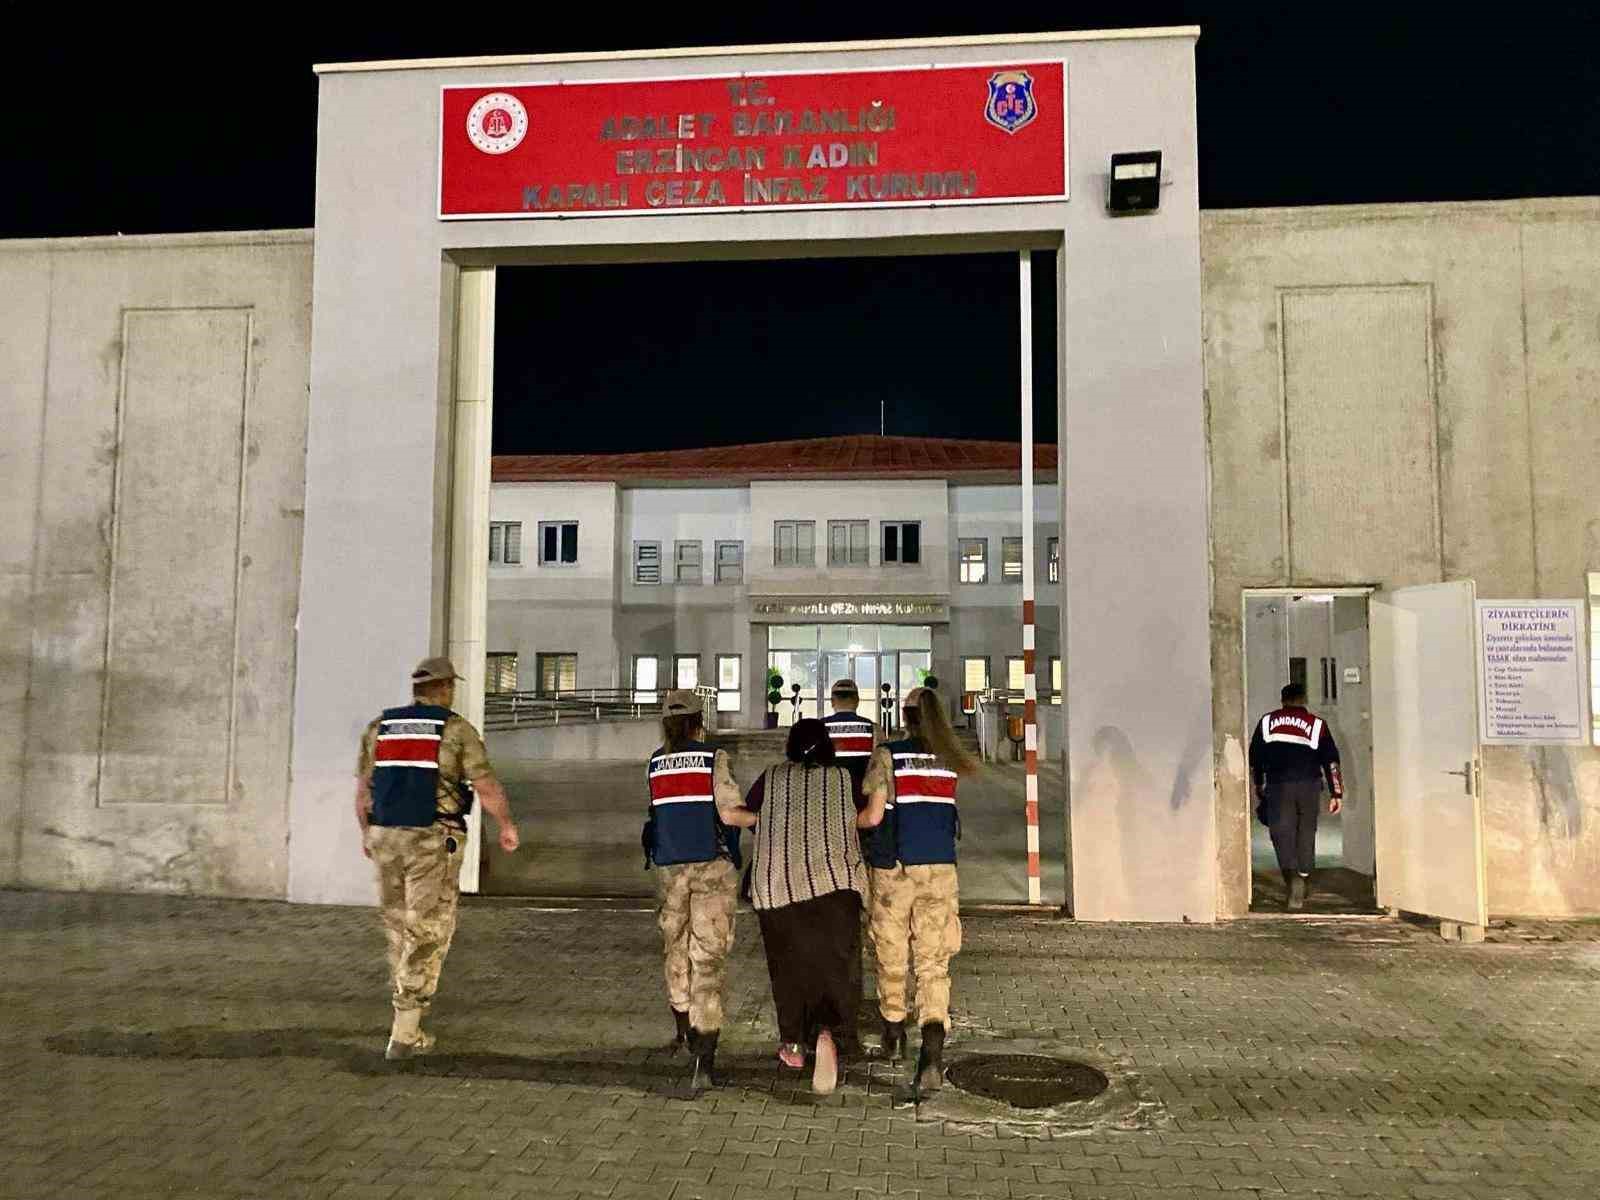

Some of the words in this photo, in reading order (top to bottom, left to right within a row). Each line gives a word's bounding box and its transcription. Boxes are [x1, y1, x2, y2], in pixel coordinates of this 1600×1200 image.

[601, 113, 714, 141] ADALET
[616, 143, 766, 174] ERZİNCAN
[782, 142, 878, 169] KADIN
[522, 183, 629, 209] KAPALI
[645, 179, 726, 207] CEZA
[744, 173, 828, 203] İNFAZ
[846, 171, 977, 200] KURUMU
[1487, 609, 1569, 619] ZİYARETÇİLERİN
[1501, 621, 1557, 631] DİKKATİNE
[1270, 715, 1312, 737] JANDARMA
[654, 756, 705, 770] JANDARMA
